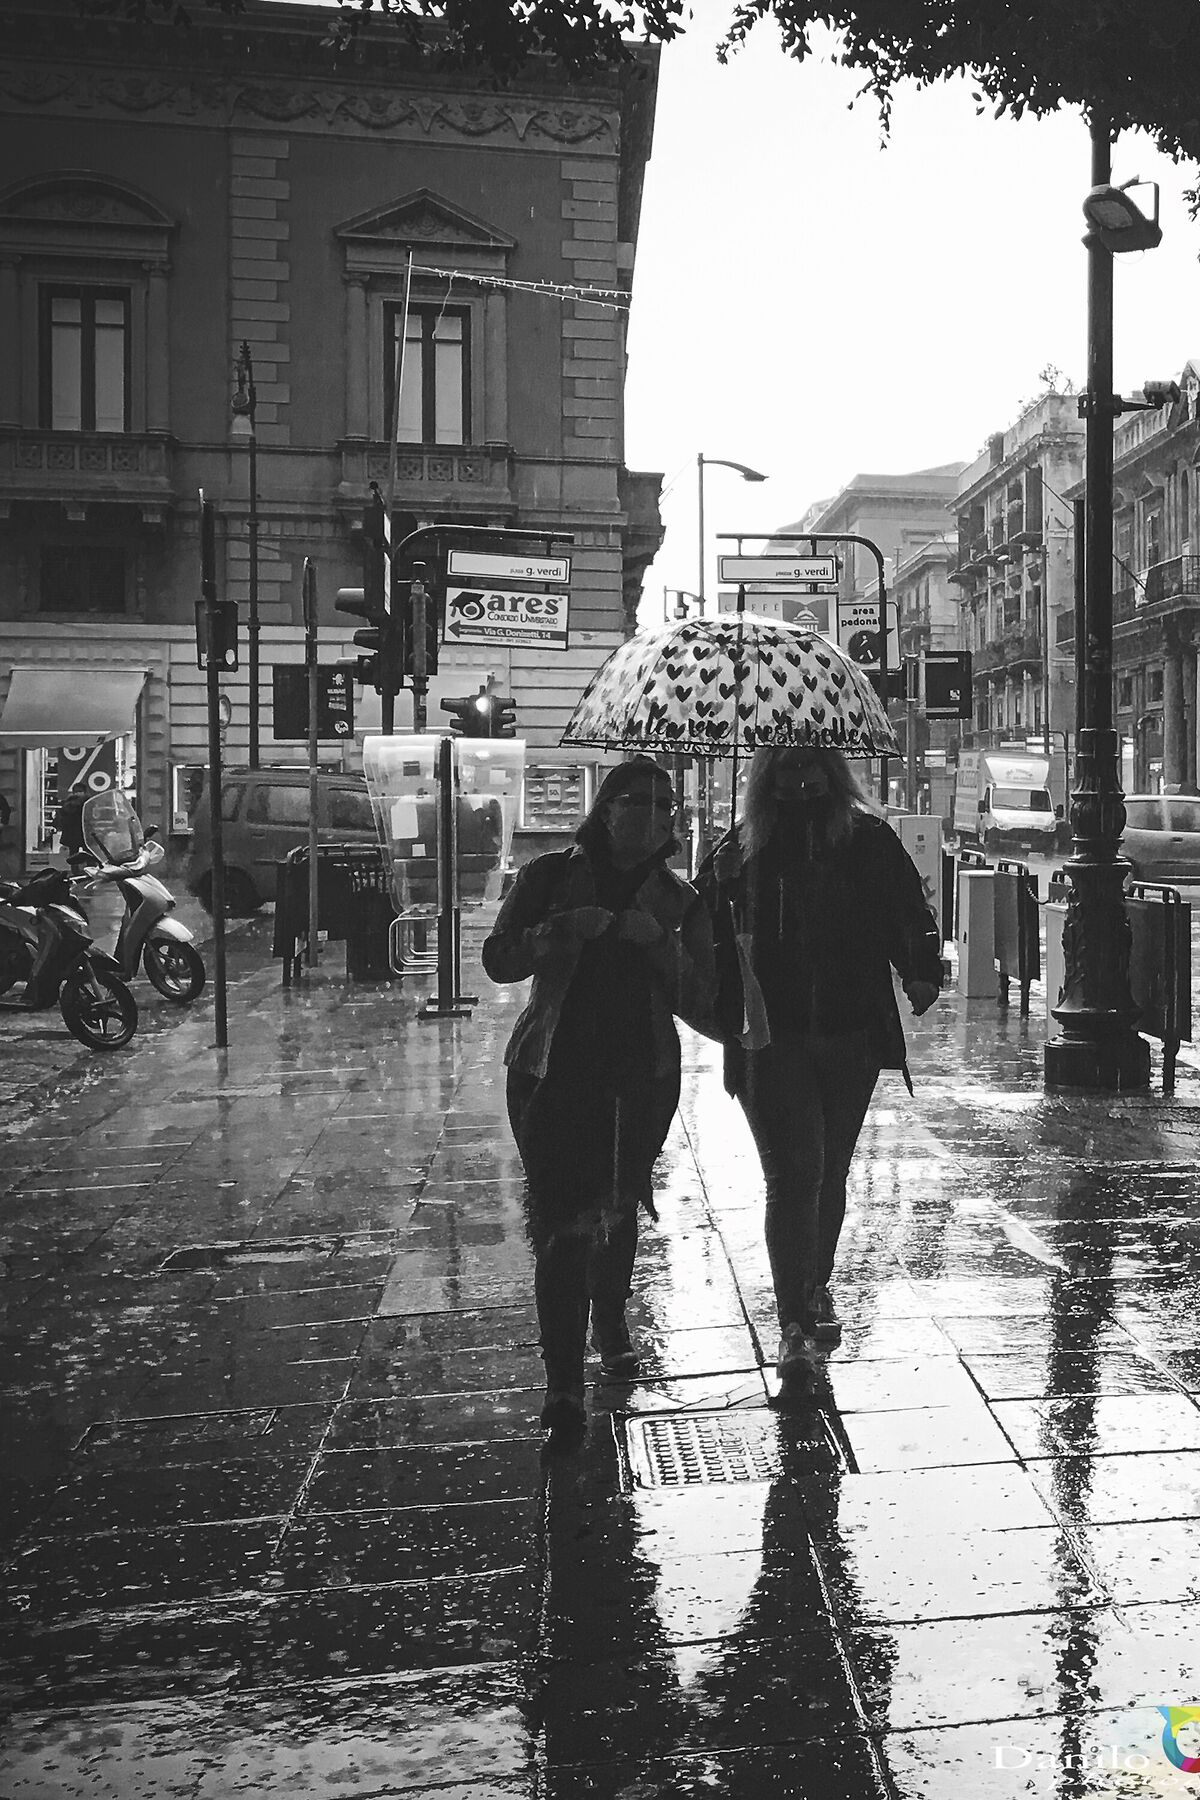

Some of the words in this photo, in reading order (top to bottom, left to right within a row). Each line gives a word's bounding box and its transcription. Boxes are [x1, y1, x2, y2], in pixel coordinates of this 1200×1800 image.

[526, 567, 535, 577] g.
[537, 567, 562, 577] verdi
[793, 569, 803, 578] g.
[804, 567, 829, 576] verdi
[483, 627, 496, 636] Via
